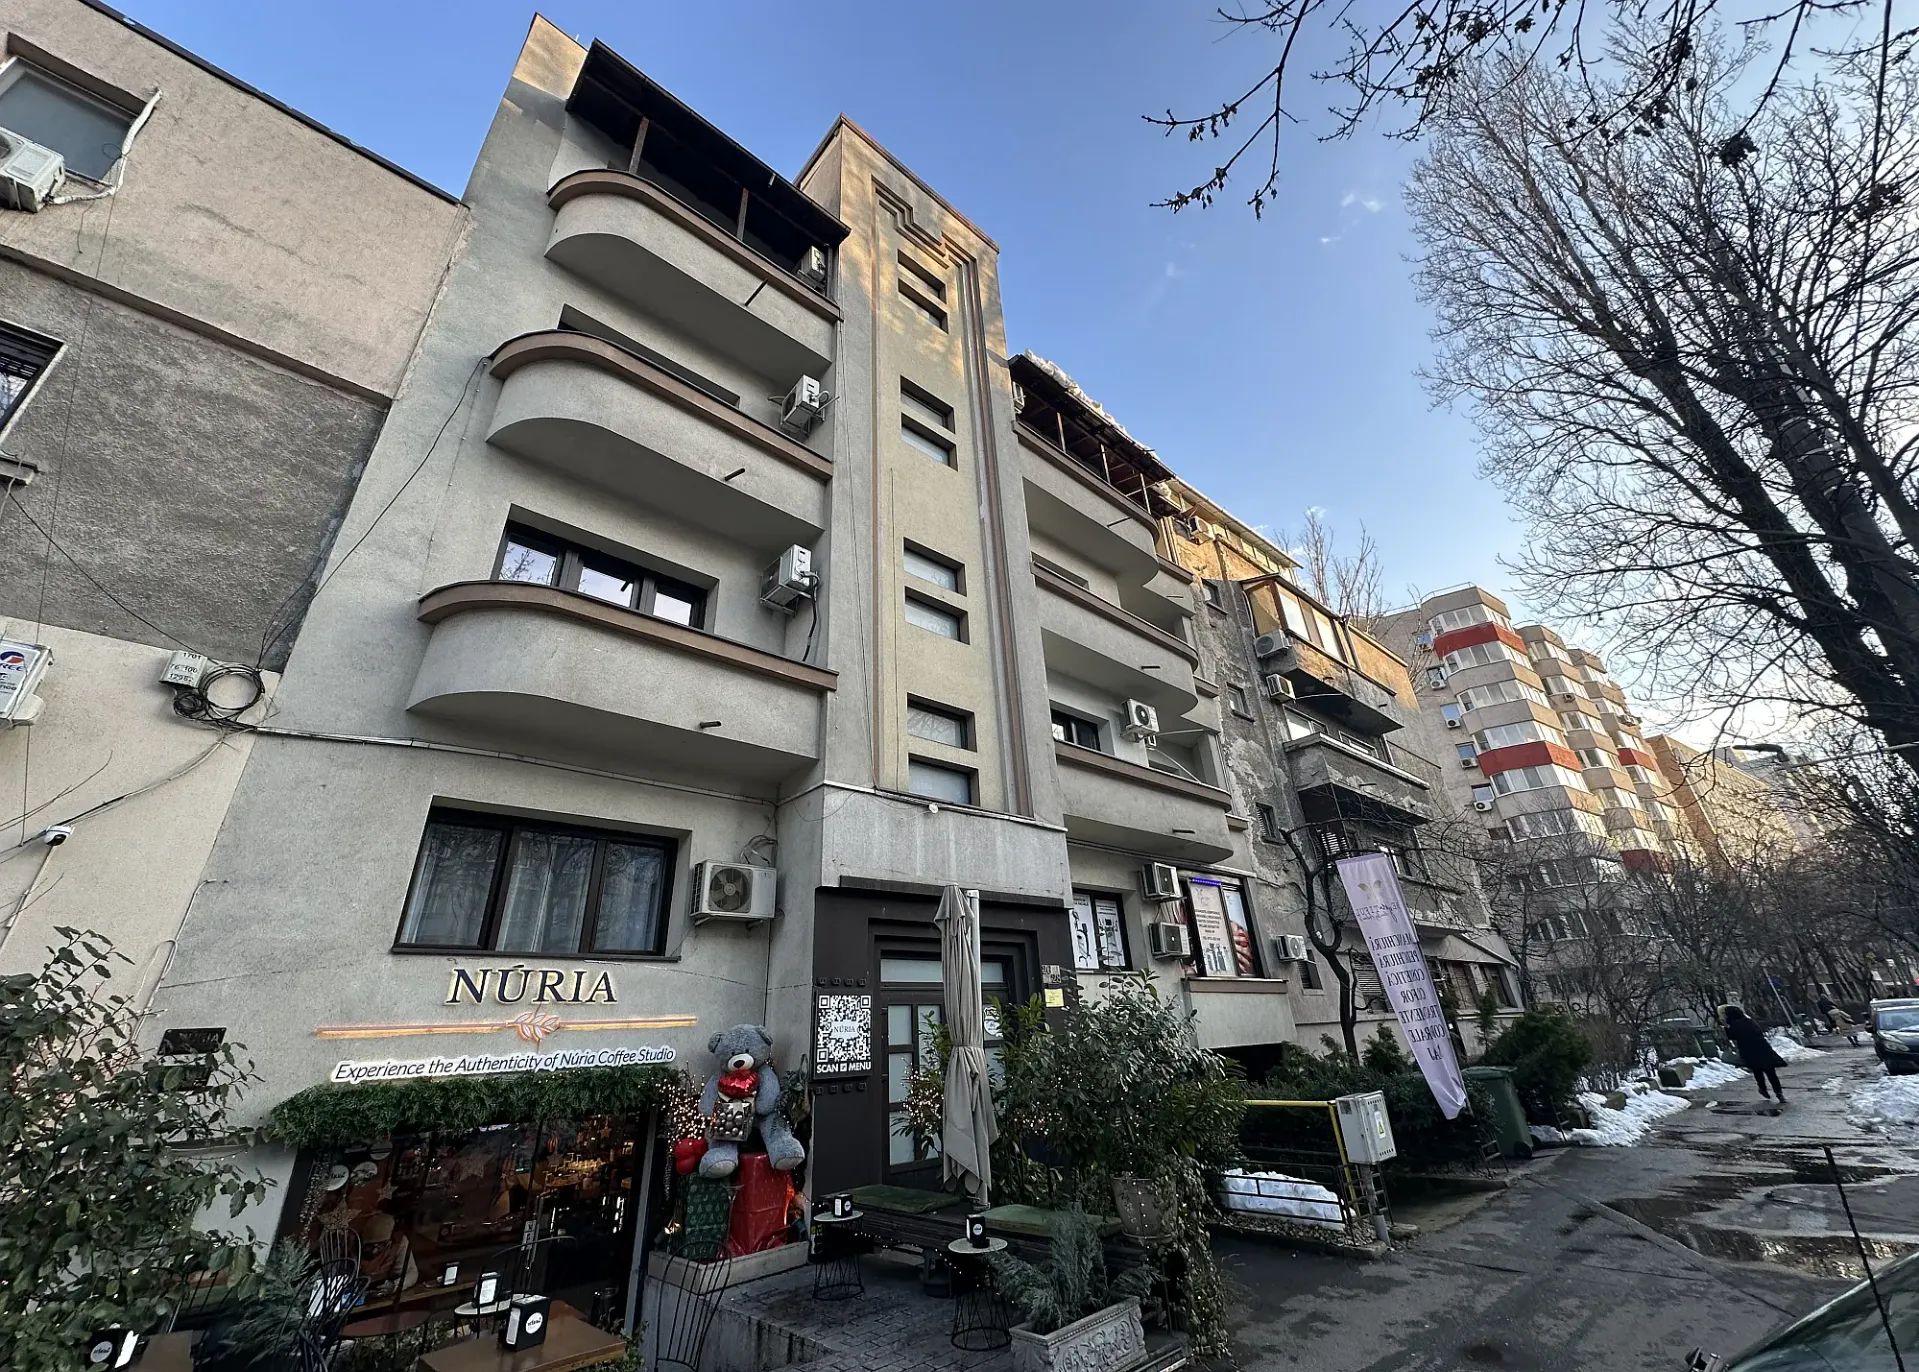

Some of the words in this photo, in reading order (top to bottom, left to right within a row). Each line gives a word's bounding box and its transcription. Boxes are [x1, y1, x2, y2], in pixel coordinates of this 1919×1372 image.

[446, 964, 618, 1003] NÚRIA
[335, 1061, 425, 1081] Experience
[428, 1059, 453, 1074] the
[454, 1053, 543, 1073] Authenticity
[543, 1053, 560, 1069] of
[560, 1051, 594, 1066] Núria
[598, 1049, 636, 1064] Coffee
[638, 1047, 674, 1062] Studio
[816, 1064, 839, 1073] SCAN
[848, 1061, 872, 1072] MENU
